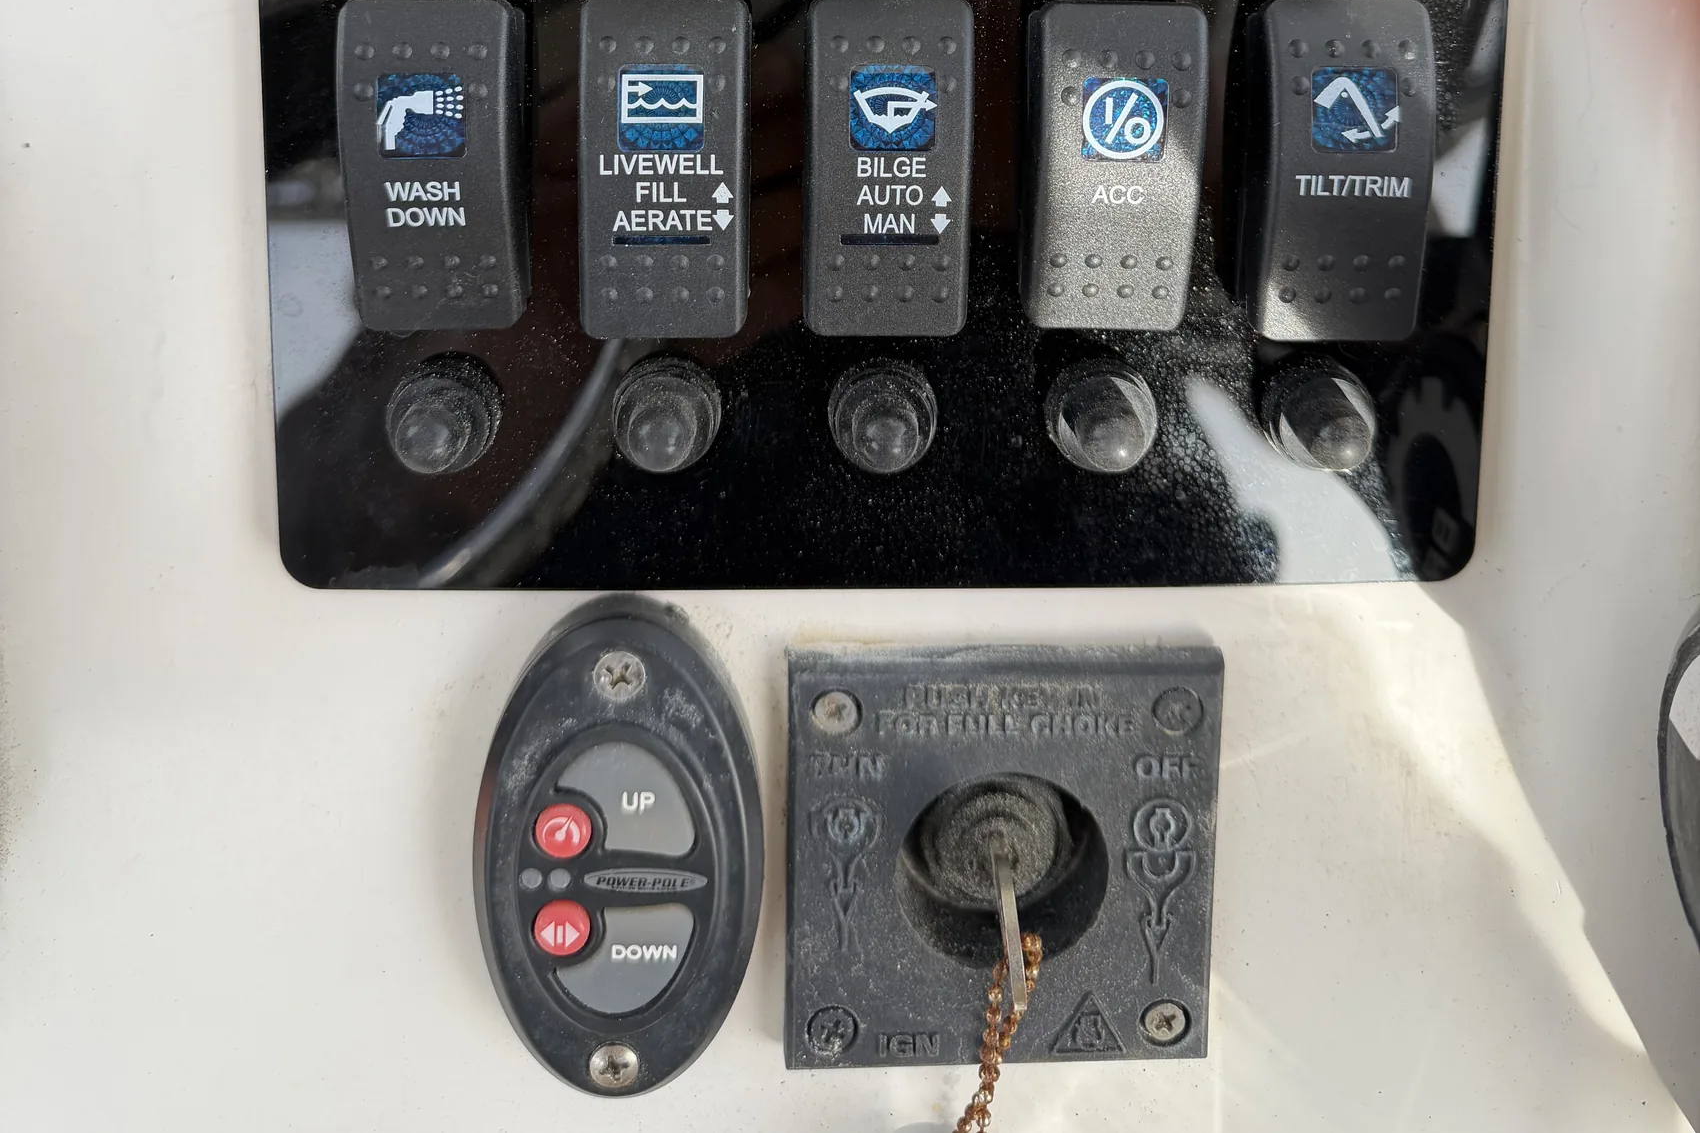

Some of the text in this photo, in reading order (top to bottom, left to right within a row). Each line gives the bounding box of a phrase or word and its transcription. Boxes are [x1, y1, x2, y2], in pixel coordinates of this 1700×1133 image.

[599, 153, 724, 176] LIVEWELL
[856, 157, 926, 178] BILGE
[384, 180, 461, 202] WASH
[635, 181, 687, 203] FILL
[856, 184, 924, 206] AUTO
[1091, 184, 1145, 205] ACC
[1295, 174, 1412, 198] TILT/TRIM
[386, 206, 466, 228] DOWN
[612, 209, 713, 232] AERATE
[863, 213, 916, 234] MAN
[876, 711, 1138, 737] FOR FULL CHOKE
[1133, 752, 1199, 782] OFF
[622, 791, 656, 813] UP
[611, 943, 678, 962] DOWN
[878, 1032, 941, 1059] IGN
